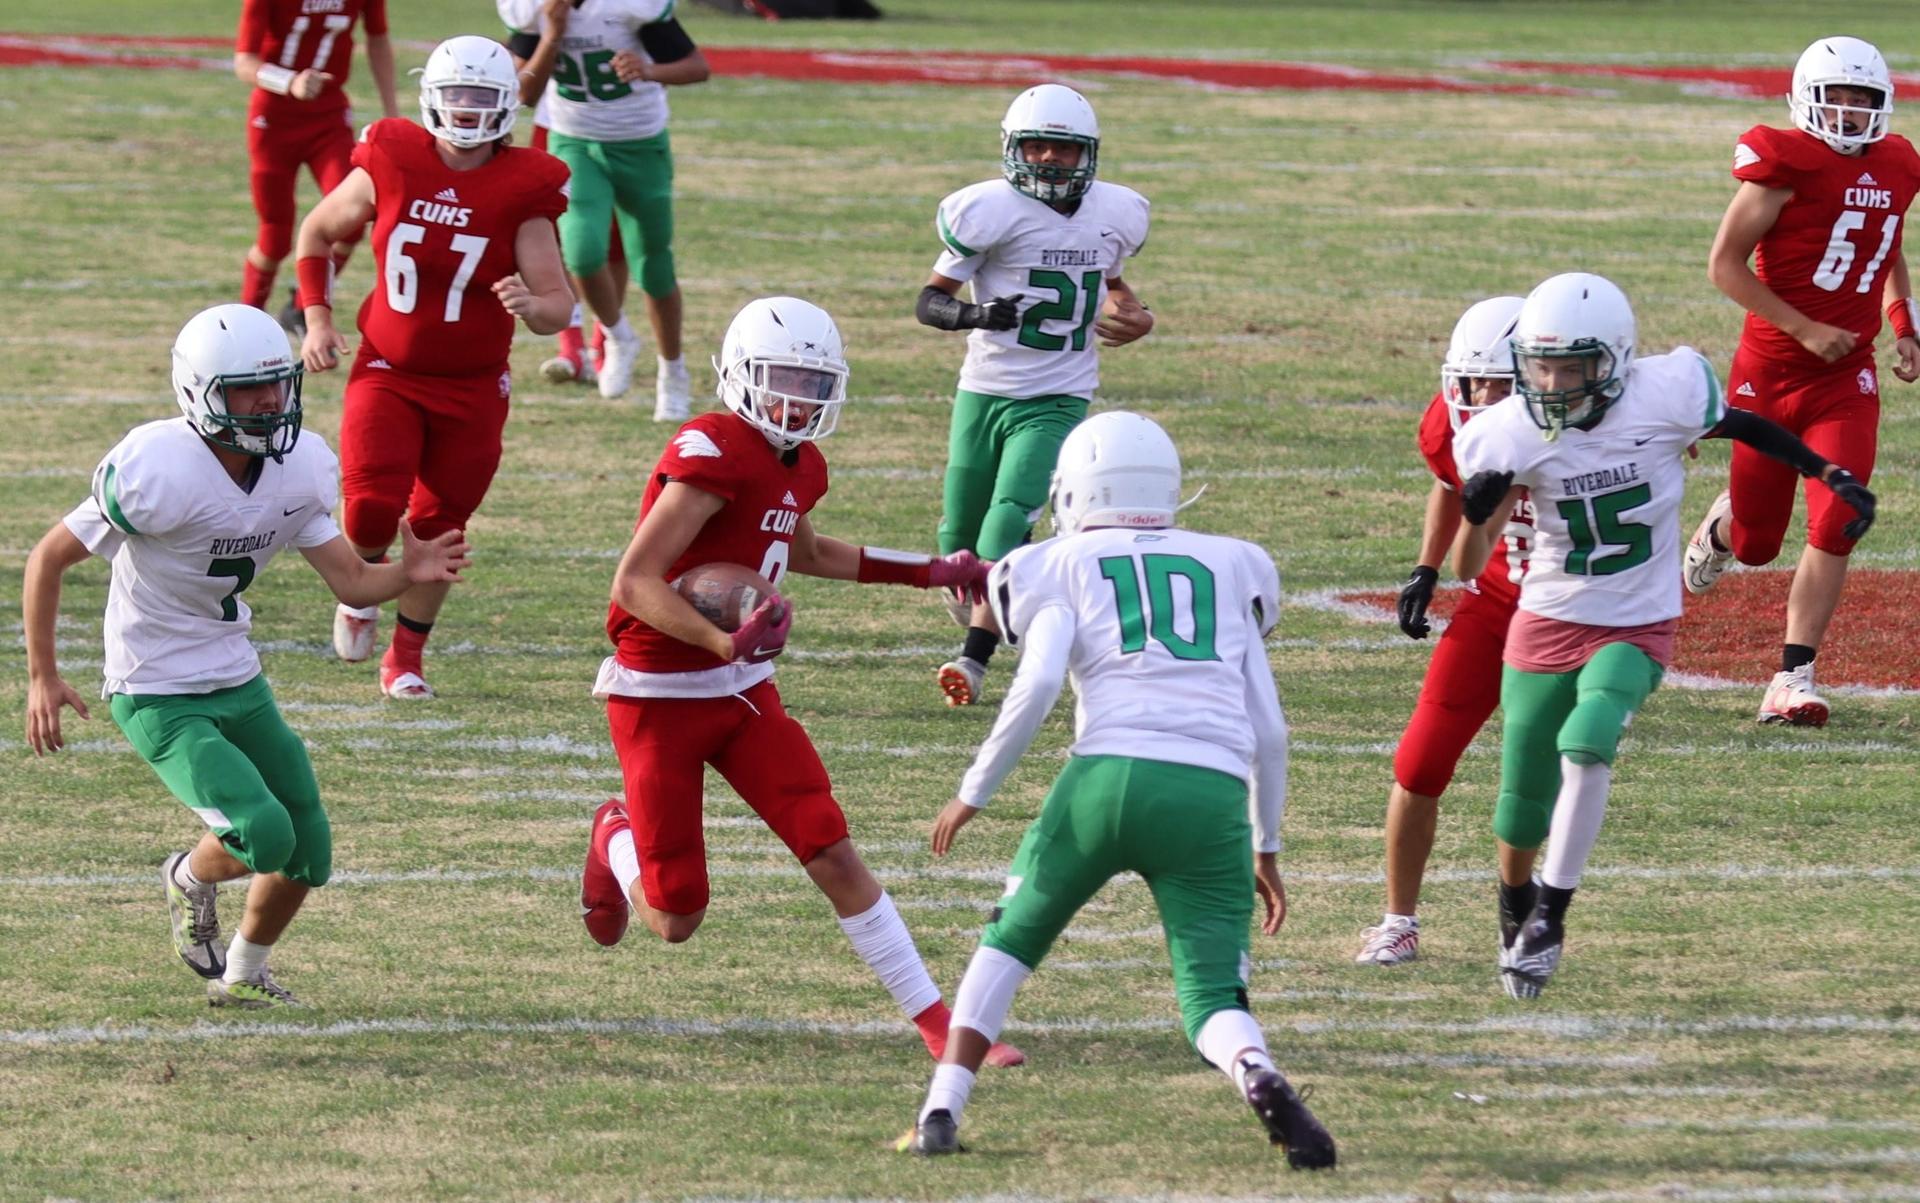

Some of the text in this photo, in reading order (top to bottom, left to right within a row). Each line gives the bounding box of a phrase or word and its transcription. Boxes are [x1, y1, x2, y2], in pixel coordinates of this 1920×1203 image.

[280, 14, 351, 71] 17
[554, 49, 633, 102] 28
[409, 199, 473, 227] CUHS
[1844, 187, 1891, 209] CUHS
[384, 222, 490, 322] 67
[1042, 249, 1098, 266] RIVERDALE
[1812, 210, 1900, 294] 61
[1017, 269, 1102, 351] 21
[1561, 462, 1639, 496] RIVERDALE
[209, 530, 276, 555] RIVERDALE
[760, 509, 800, 536] CUH
[1556, 481, 1653, 576] 15
[206, 556, 256, 622] 7
[1098, 553, 1223, 662] 10
